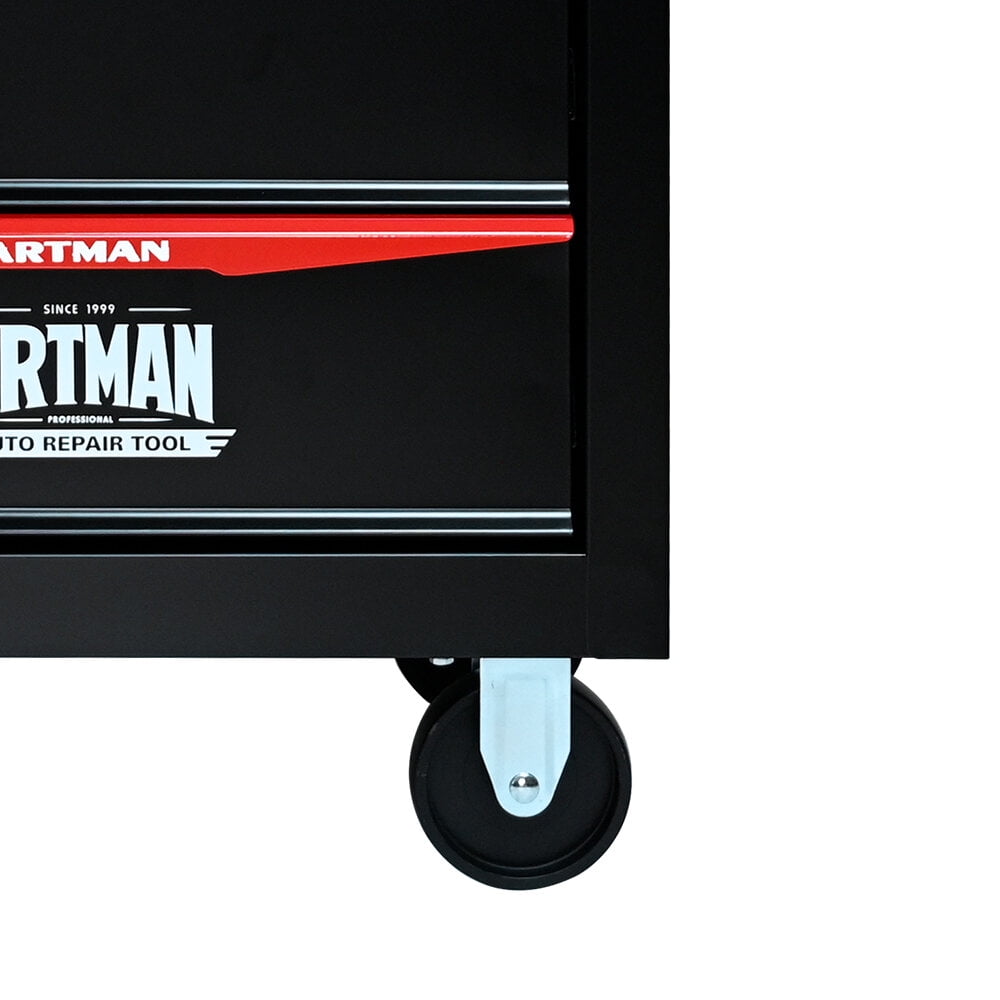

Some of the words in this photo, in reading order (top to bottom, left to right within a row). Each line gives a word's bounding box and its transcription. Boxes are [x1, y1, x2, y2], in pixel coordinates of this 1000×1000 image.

[43, 303, 79, 315] SINCE
[86, 303, 116, 315] 1999
[47, 415, 114, 424] PROFESSIONAL
[43, 436, 124, 451] REPAIR
[131, 435, 191, 451] TOOL
